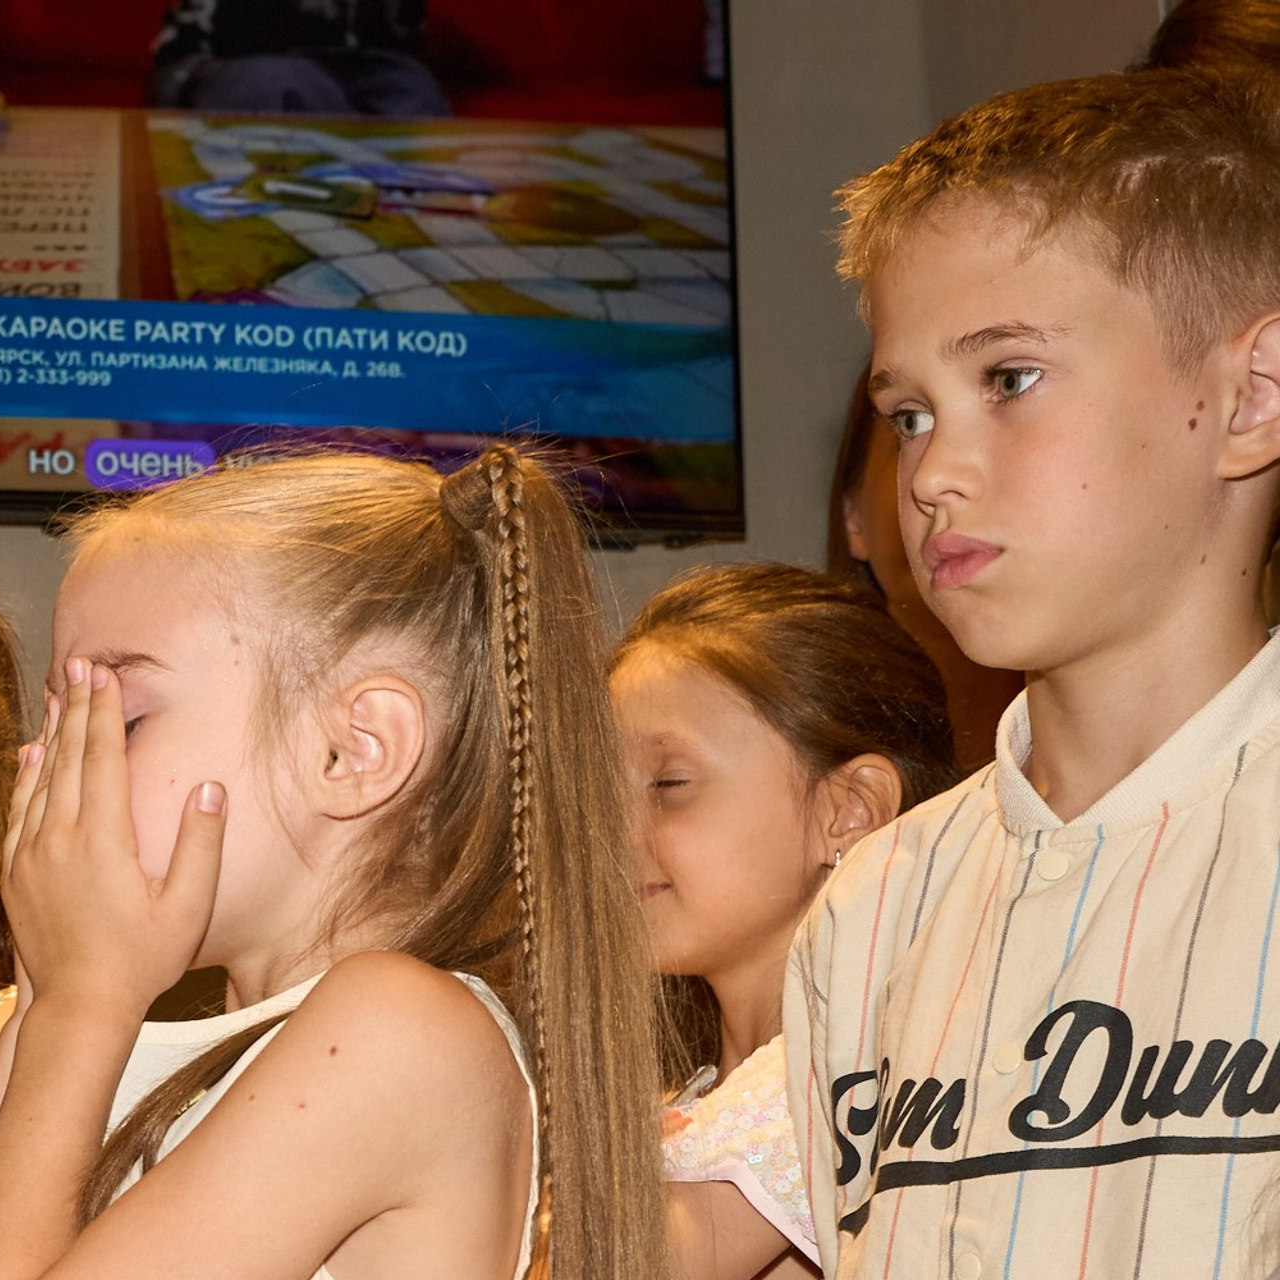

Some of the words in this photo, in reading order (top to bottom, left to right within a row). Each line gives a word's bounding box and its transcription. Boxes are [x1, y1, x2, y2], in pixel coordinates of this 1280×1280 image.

[135, 319, 226, 345] PARTY
[234, 325, 295, 348] KOD
[303, 327, 390, 351] (ПАТИ
[397, 331, 468, 357] КОД)
[91, 351, 207, 372] ПАРТИЗАНА
[17, 368, 113, 387] 2-333-999
[28, 449, 75, 475] но
[95, 450, 204, 478] очень
